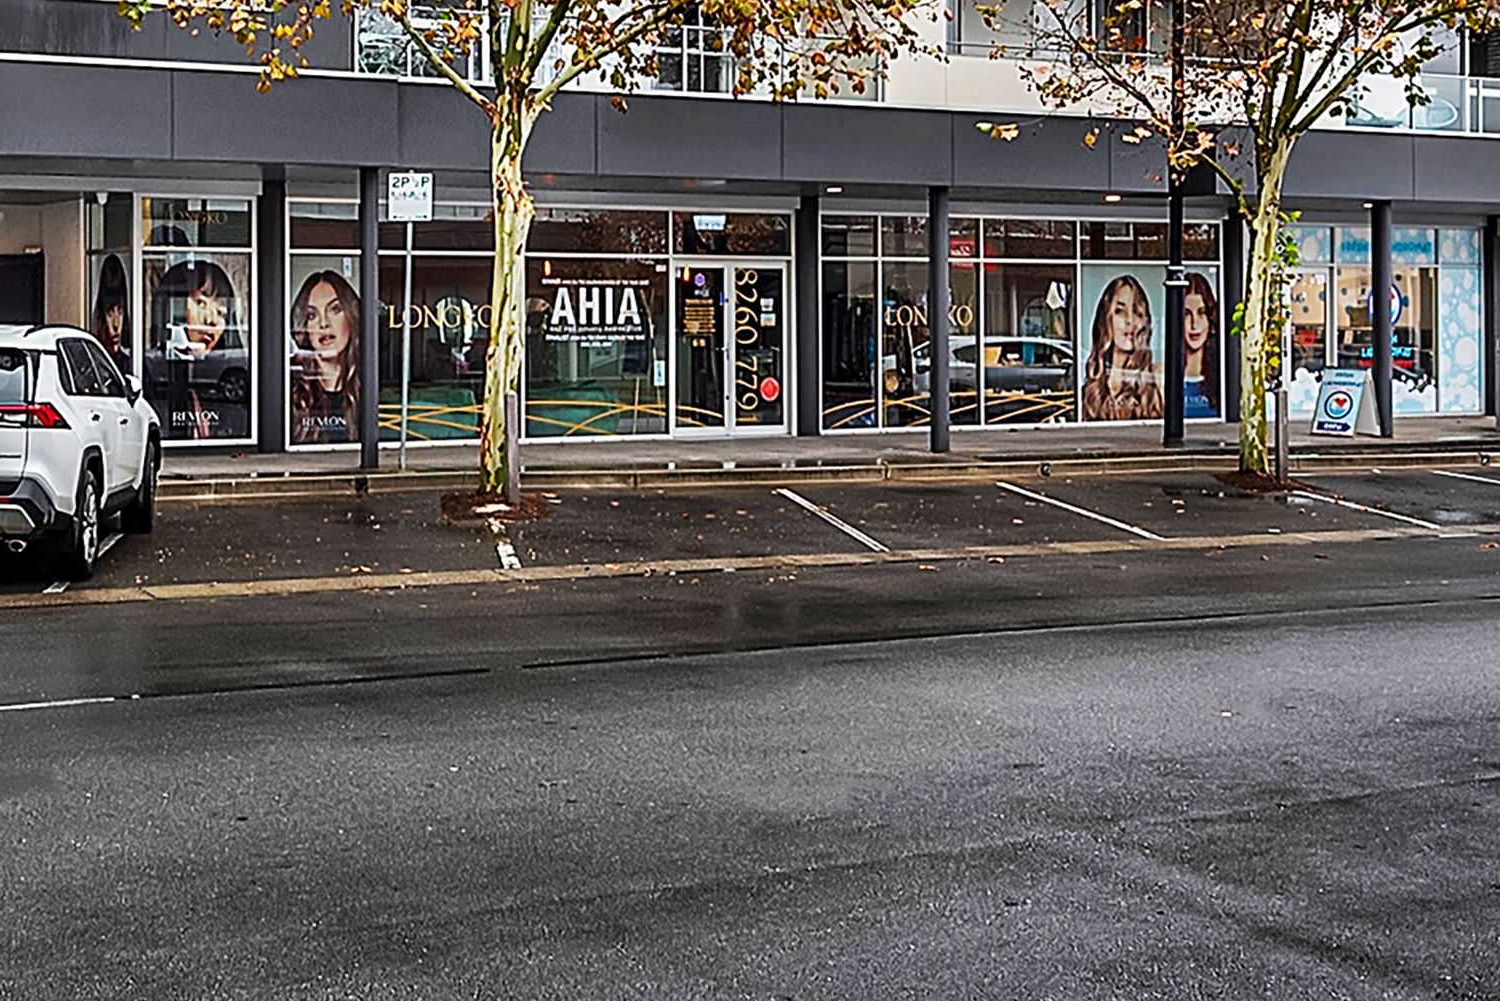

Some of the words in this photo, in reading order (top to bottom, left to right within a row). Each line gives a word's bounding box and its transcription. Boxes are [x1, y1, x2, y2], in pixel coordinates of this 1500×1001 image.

[392, 176, 410, 188] 2P
[550, 287, 642, 325] AHIA
[885, 304, 974, 327] LONKO
